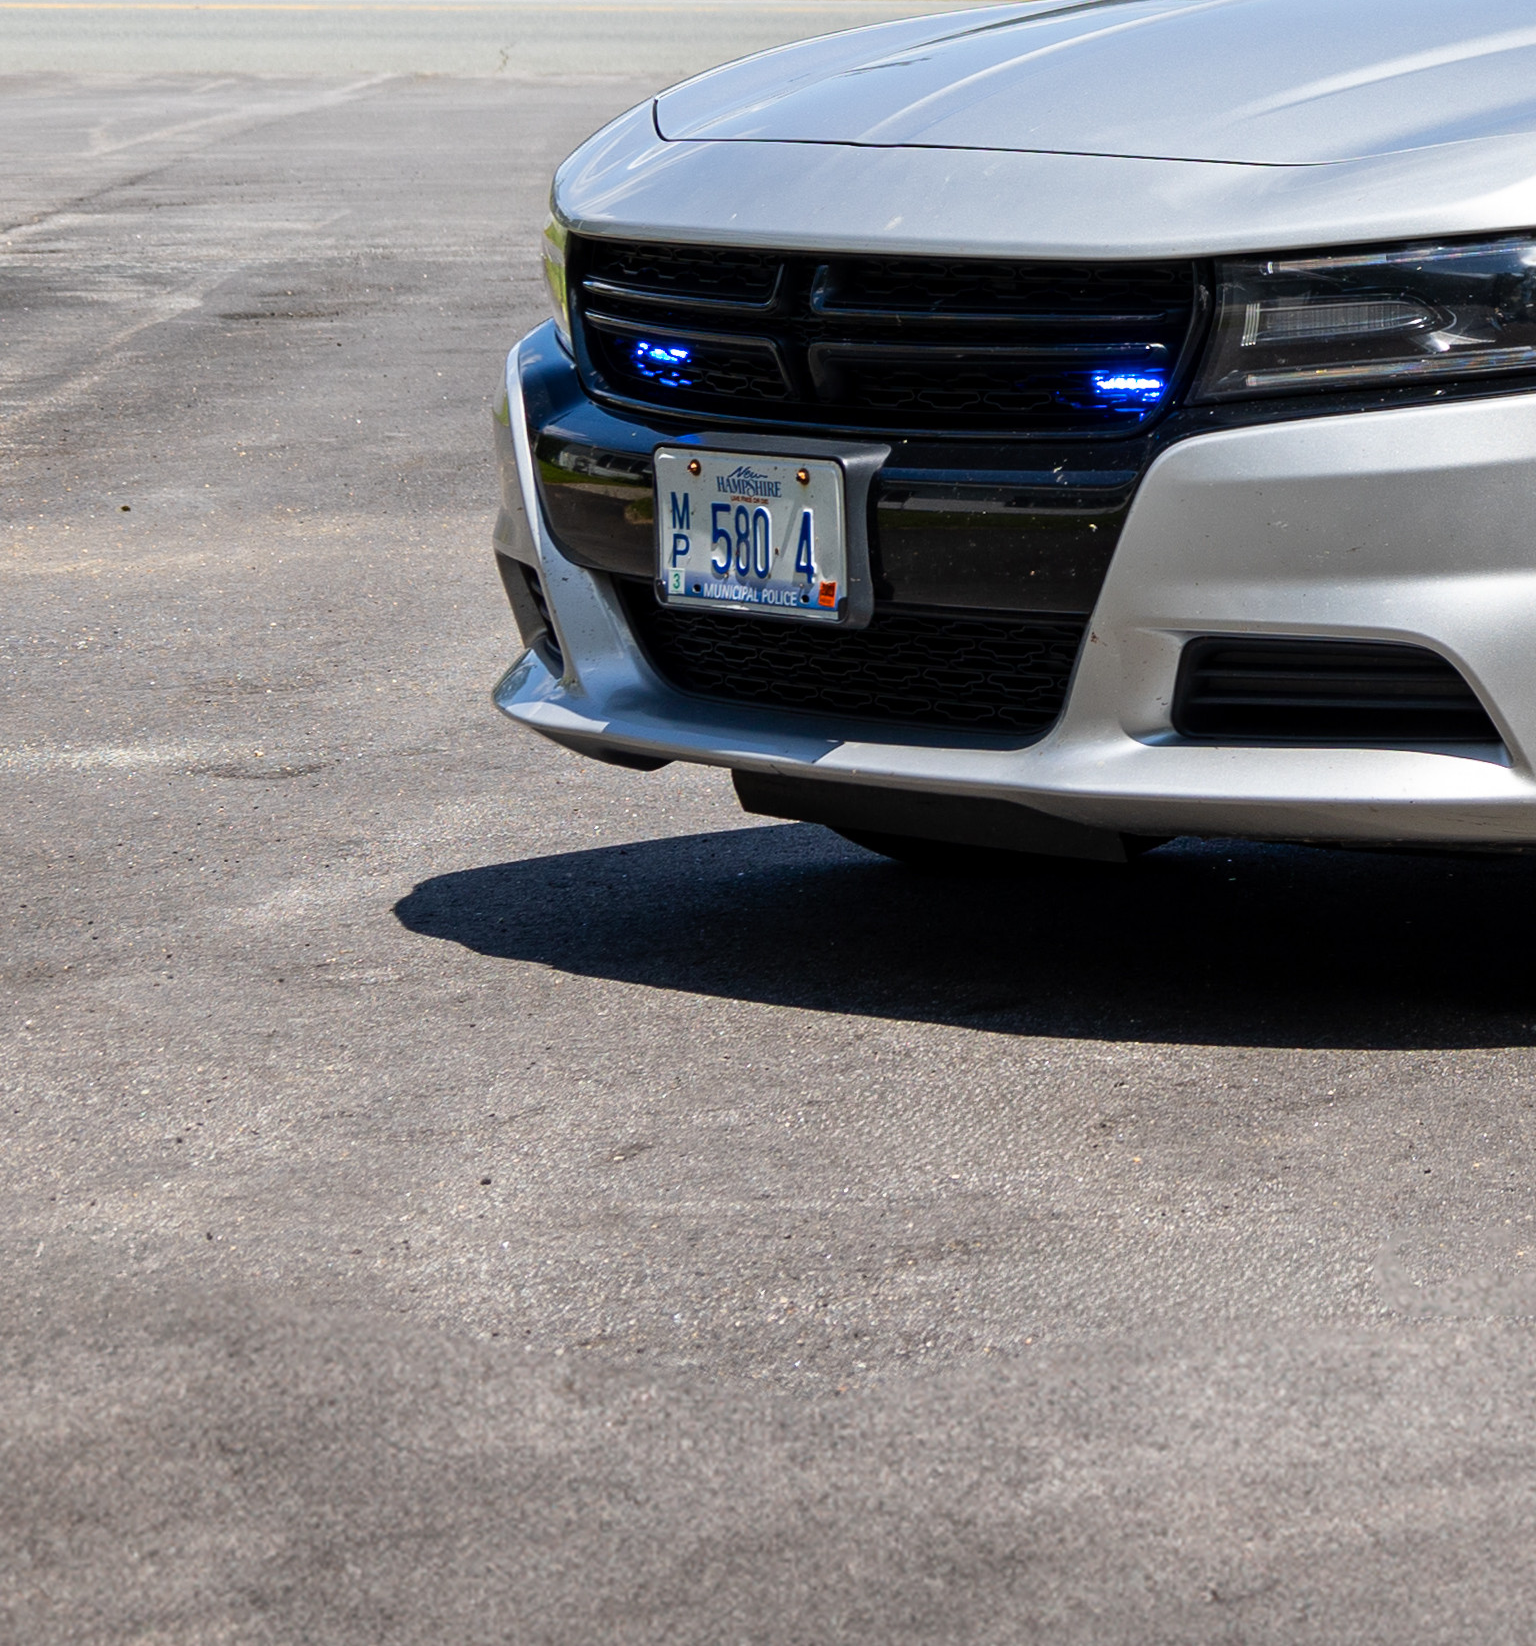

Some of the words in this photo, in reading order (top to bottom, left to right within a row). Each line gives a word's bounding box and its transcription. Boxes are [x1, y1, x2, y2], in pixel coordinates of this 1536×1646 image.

[727, 466, 769, 479] New
[716, 476, 782, 498] HAMPSHIRE
[711, 502, 771, 579] 580
[795, 509, 816, 584] 4
[703, 583, 759, 603] MUNICIPAL
[761, 590, 798, 607] POLICE
